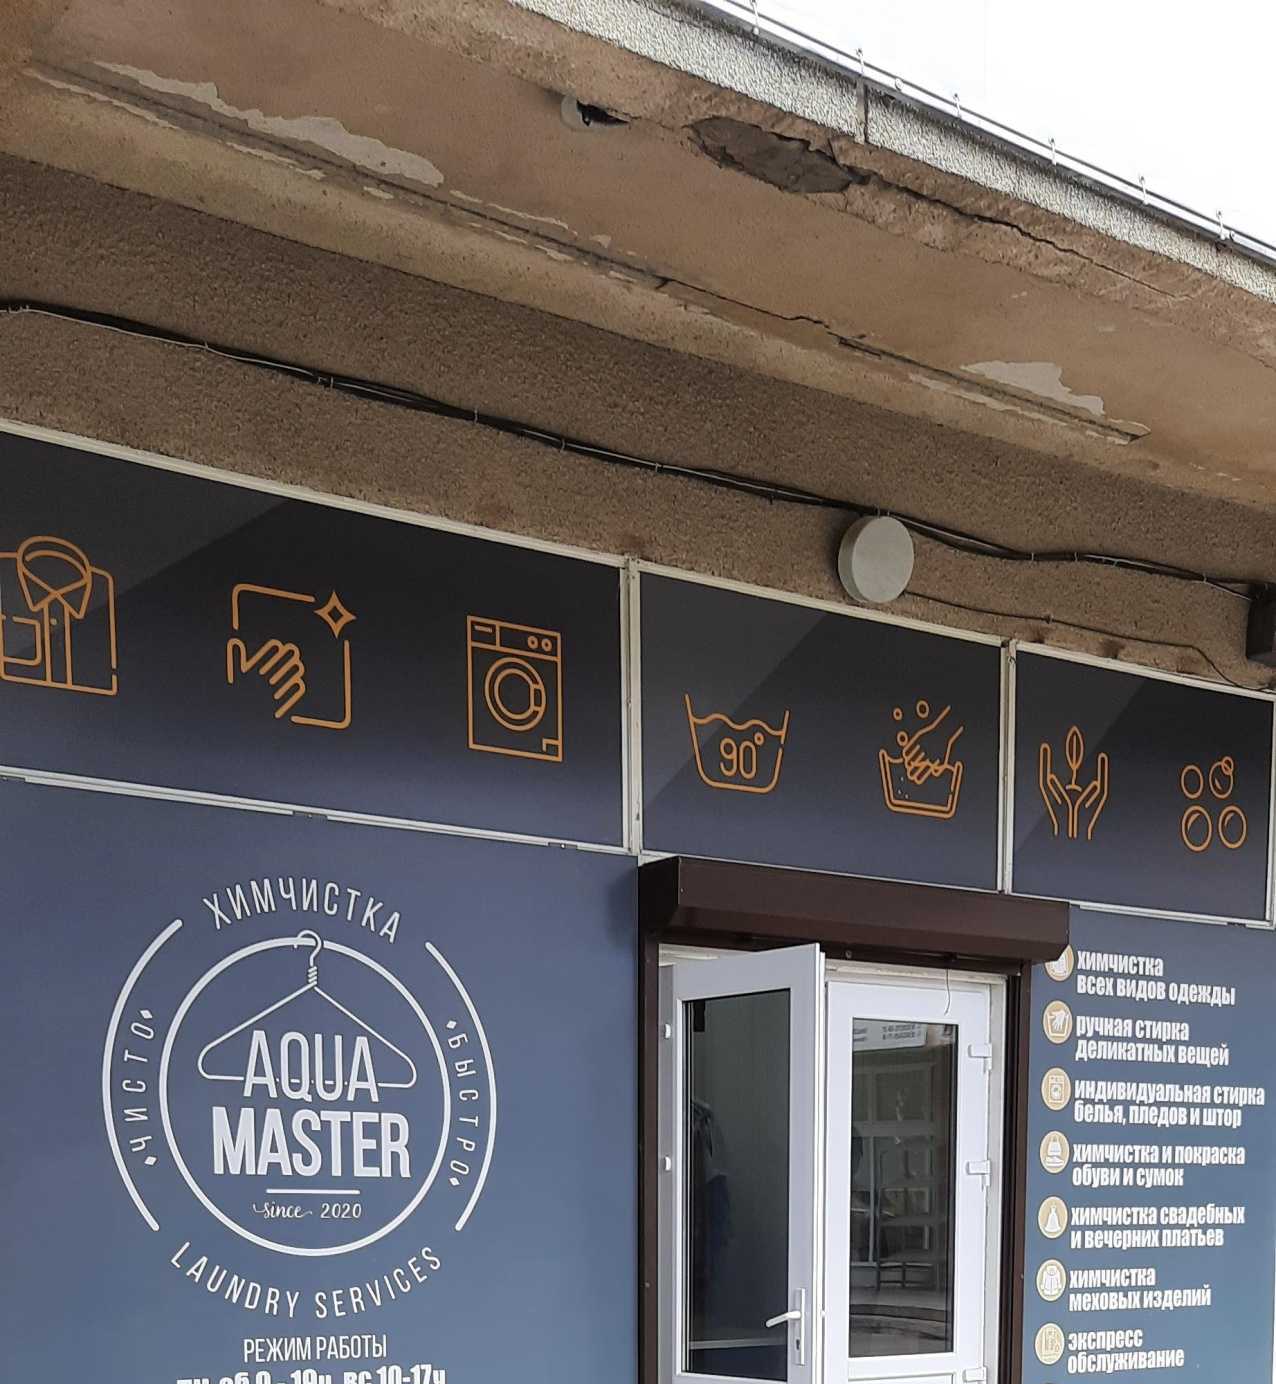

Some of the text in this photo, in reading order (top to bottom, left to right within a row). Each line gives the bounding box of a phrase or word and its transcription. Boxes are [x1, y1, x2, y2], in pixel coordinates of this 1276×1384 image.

[203, 877, 400, 943] ХИМЧИСТКА
[1077, 950, 1164, 976] химчистка
[1077, 975, 1235, 1007] всех видов одежды
[1076, 1015, 1189, 1041] ручная стирка
[243, 1030, 379, 1102] AQUA
[1075, 1039, 1229, 1067] деликатных вещей
[122, 1022, 155, 1151] ЧИСТО
[1074, 1080, 1265, 1106] индивидуальная стирка
[447, 1033, 479, 1174] БЫСТРО
[1074, 1101, 1241, 1128] белья, пледов и штор
[212, 1106, 411, 1177] MASTER
[1072, 1144, 1245, 1166] химчистка и покраска
[1072, 1164, 1184, 1188] обуви и сумок
[253, 1202, 362, 1219] since 2020
[1071, 1204, 1245, 1227] химчистка свадебных
[1071, 1229, 1224, 1249] и вечерних платьев
[170, 1242, 440, 1318] LAUNDRY SERVICES
[1070, 1268, 1155, 1288] химчистка
[1069, 1284, 1211, 1311] меховых изделий
[244, 1334, 386, 1363] РЕЖИМ РАБОТЫ
[1068, 1330, 1143, 1351] экспресс
[1068, 1349, 1184, 1374] обслуживание
